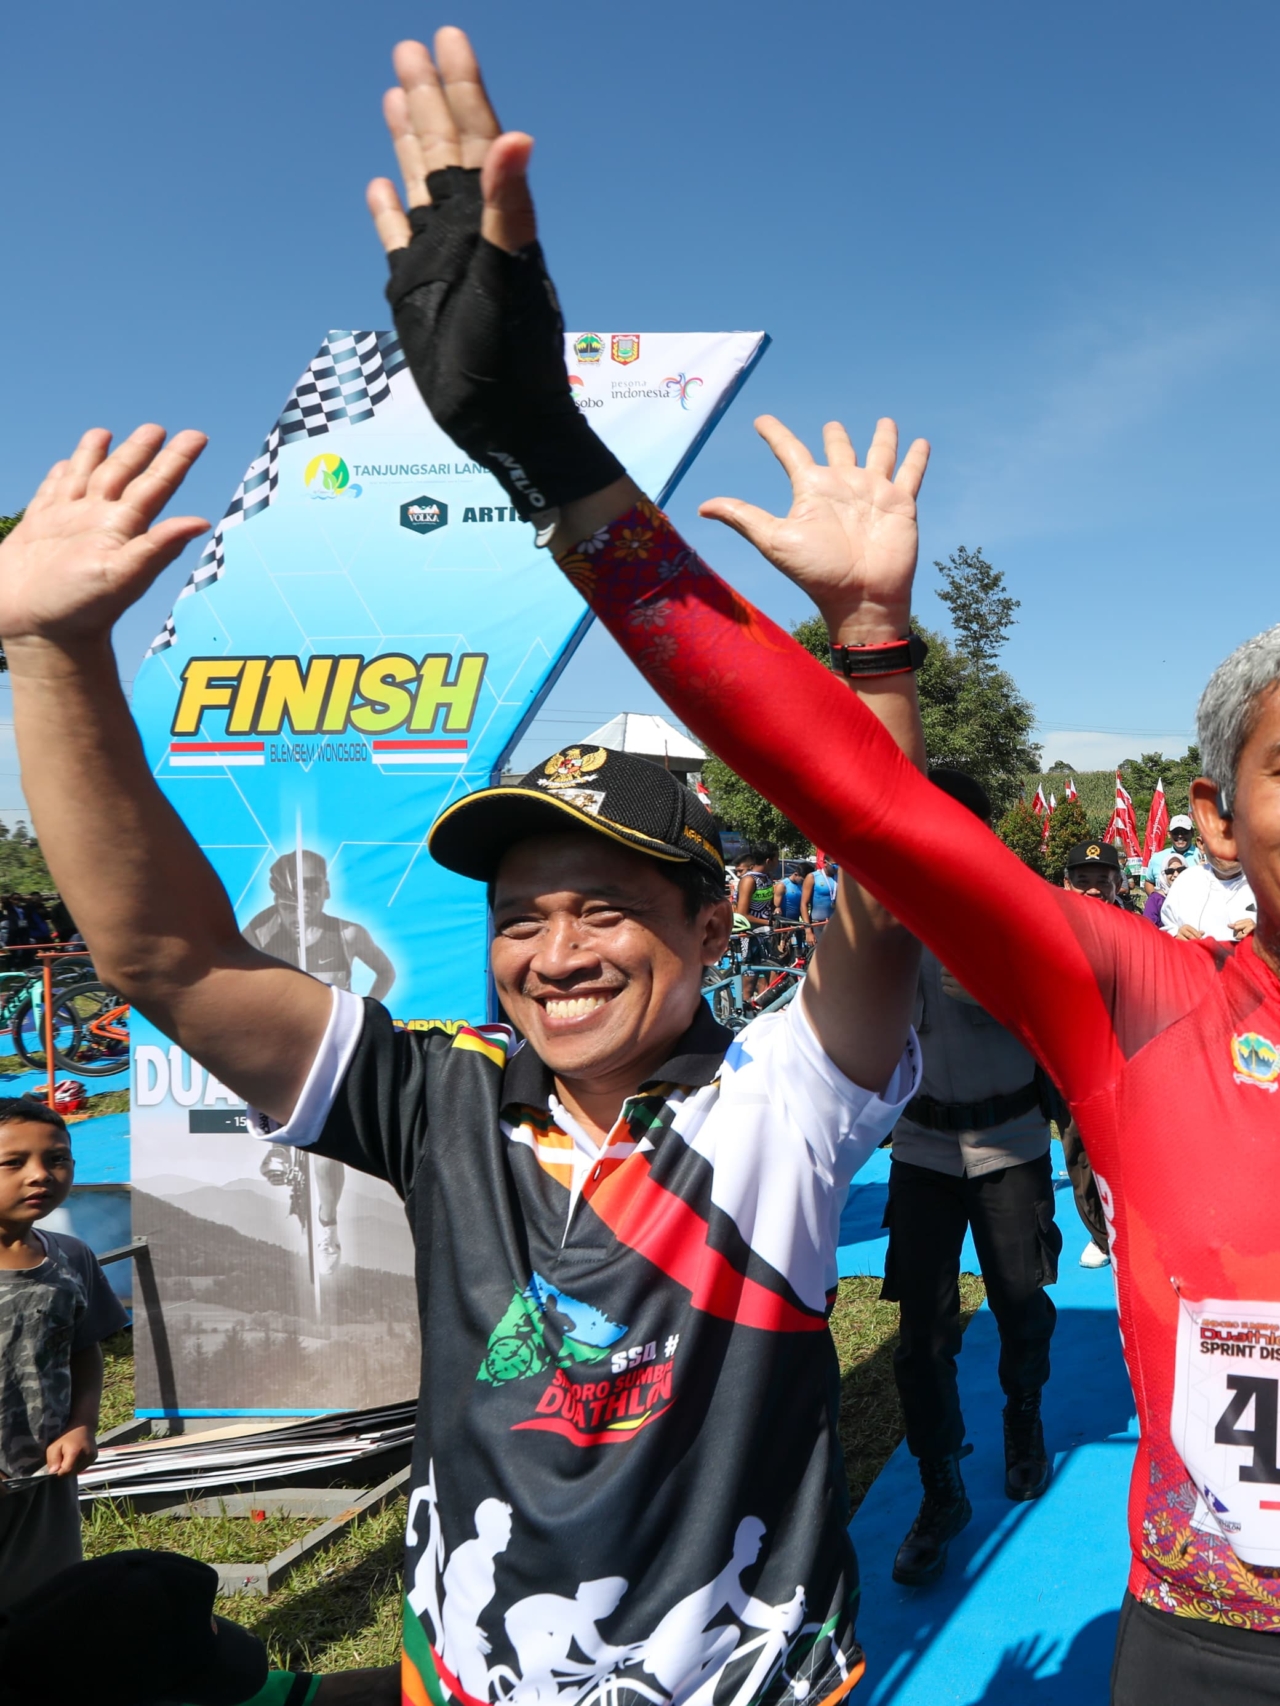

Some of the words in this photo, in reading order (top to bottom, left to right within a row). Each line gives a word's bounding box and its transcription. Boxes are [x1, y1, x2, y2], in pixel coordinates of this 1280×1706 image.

[611, 380, 647, 389] pesona
[611, 387, 671, 399] indonesia
[353, 464, 451, 477] TANJUNGSARI
[408, 513, 440, 522] VOLKA
[170, 652, 489, 737] FINISH
[317, 742, 368, 762] WONOSOBO
[1200, 1341, 1256, 1359] SPRINT
